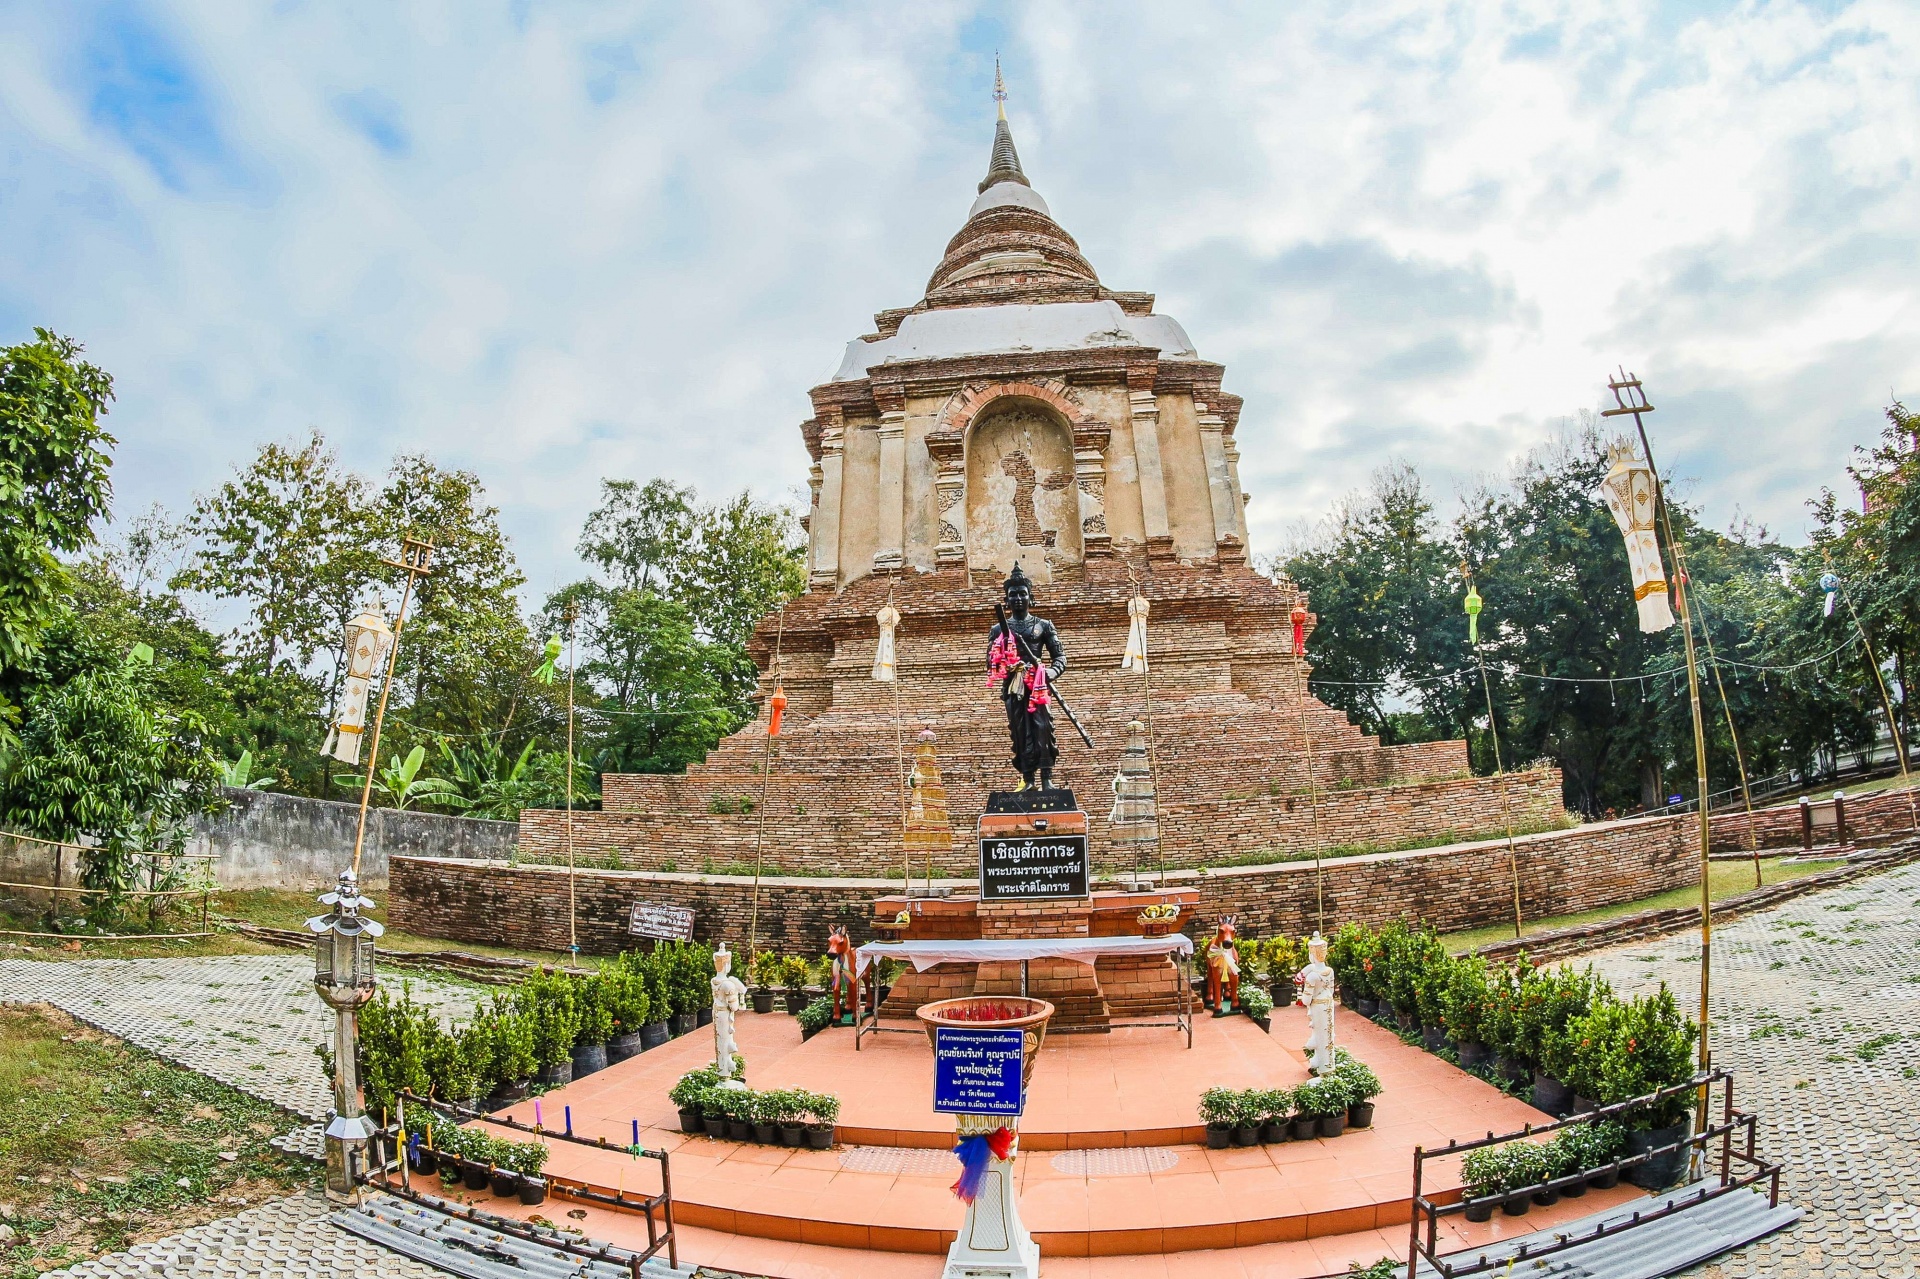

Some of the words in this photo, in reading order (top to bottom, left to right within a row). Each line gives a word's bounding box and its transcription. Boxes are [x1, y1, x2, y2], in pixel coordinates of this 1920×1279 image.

[991, 841, 1075, 863] เชิญสักการะ
[987, 861, 1081, 878] พระบรมราชานุสาวรีย์
[997, 880, 1070, 893] พระเจ้าติโลกราช
